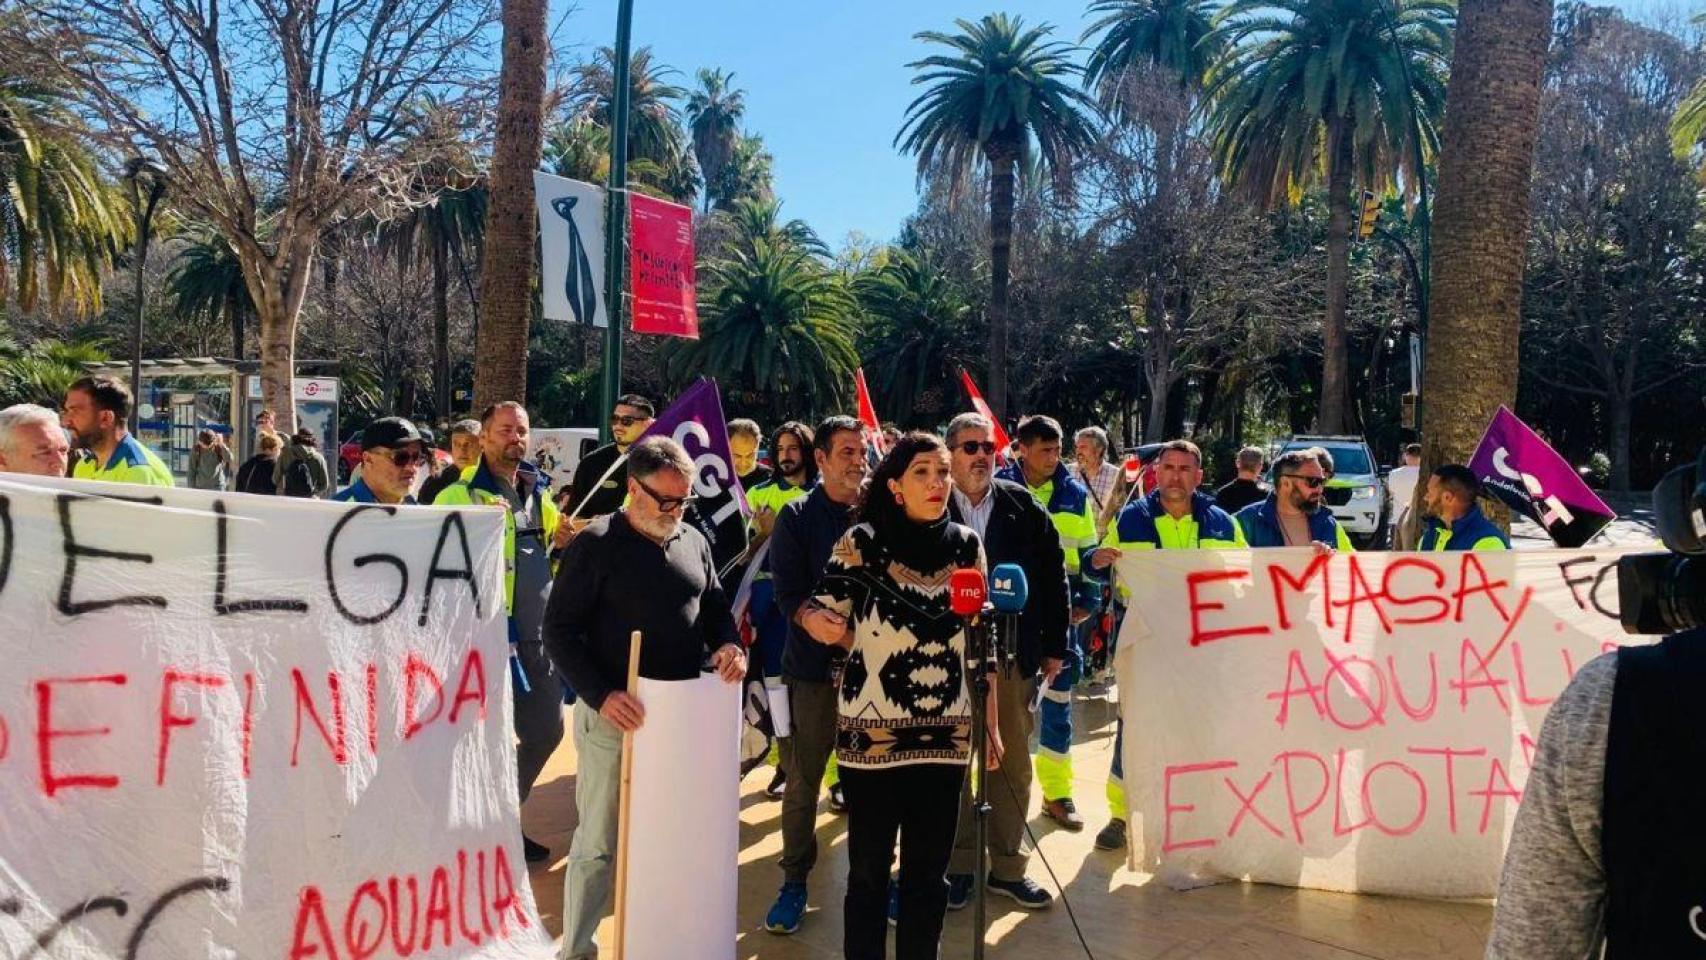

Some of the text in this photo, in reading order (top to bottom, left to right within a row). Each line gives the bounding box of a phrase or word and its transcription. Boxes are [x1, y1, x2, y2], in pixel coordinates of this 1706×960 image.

[671, 420, 741, 527] CGT
[961, 587, 981, 598] rne
[0, 648, 486, 797] EFINIDA
[289, 845, 530, 960] AQUALIA
